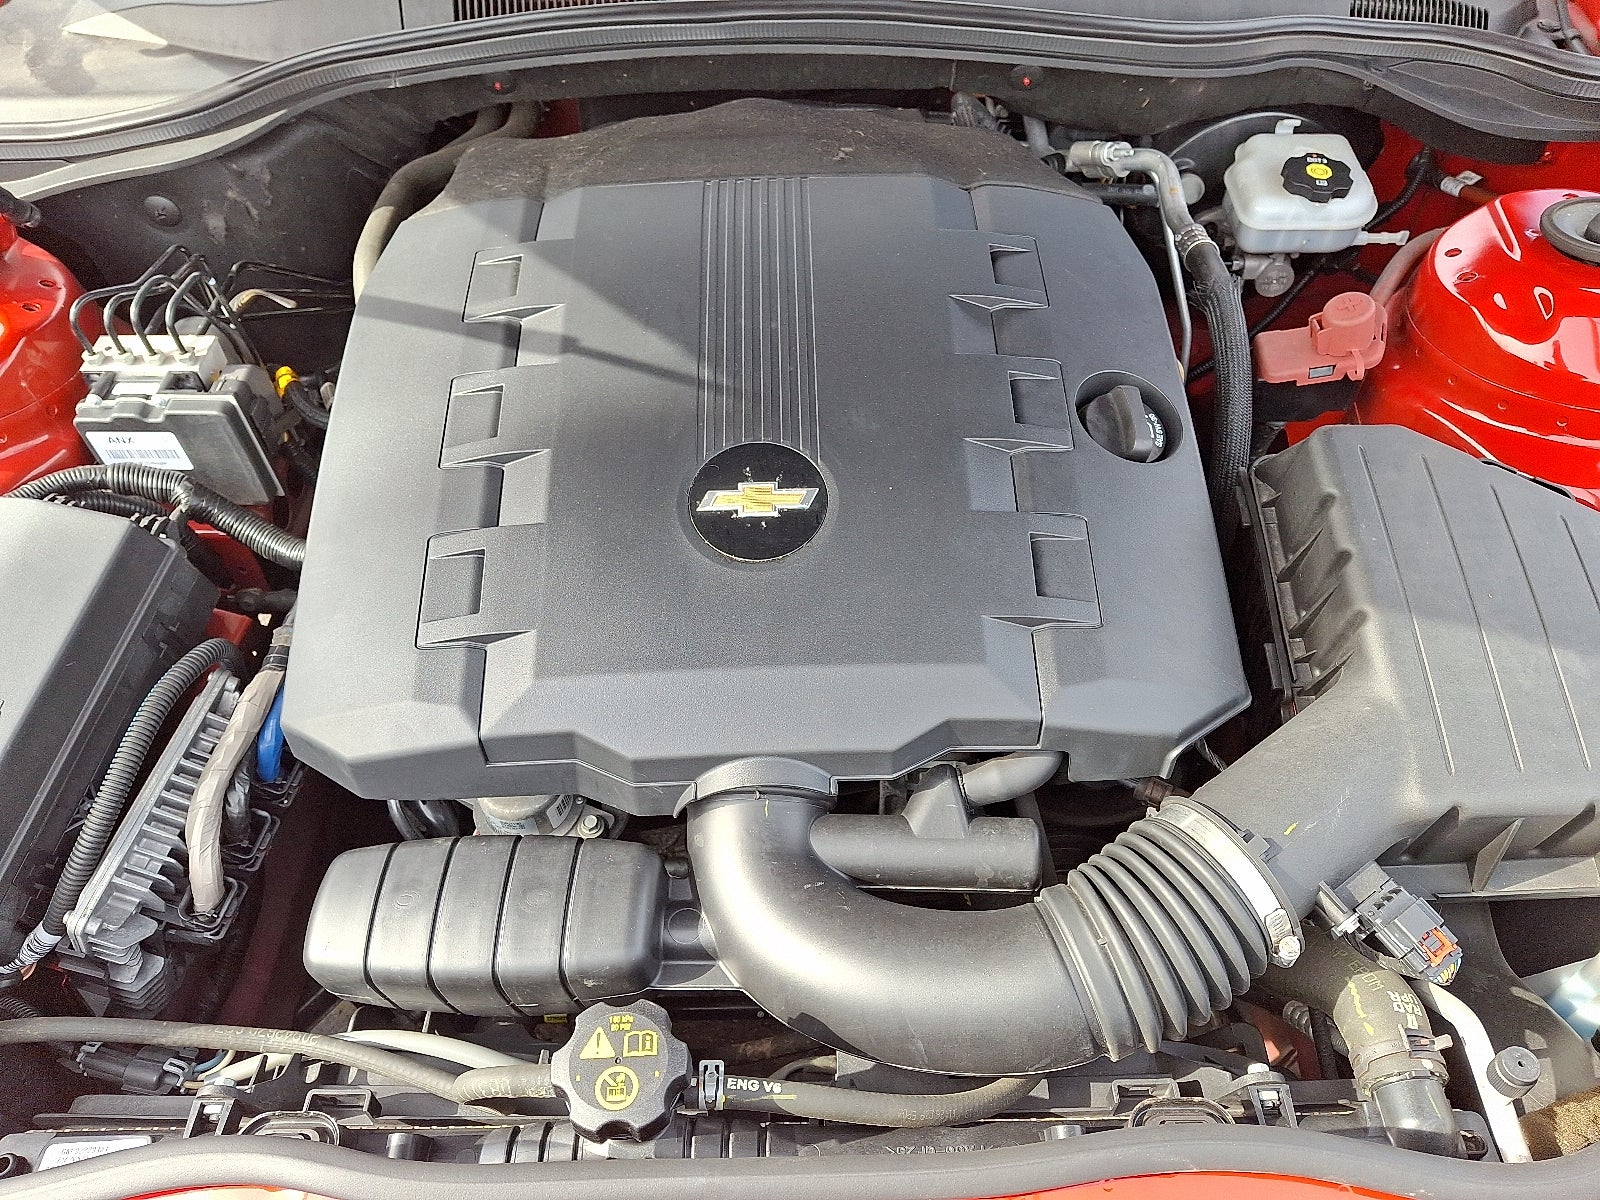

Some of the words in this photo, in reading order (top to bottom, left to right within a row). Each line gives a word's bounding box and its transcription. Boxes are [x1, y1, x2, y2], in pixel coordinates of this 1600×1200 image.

[1148, 412, 1163, 435] 5W-30
[1154, 434, 1164, 448] SAE
[1347, 960, 1385, 992] EPDM
[726, 1077, 760, 1092] ENG
[762, 1080, 782, 1094] V6
